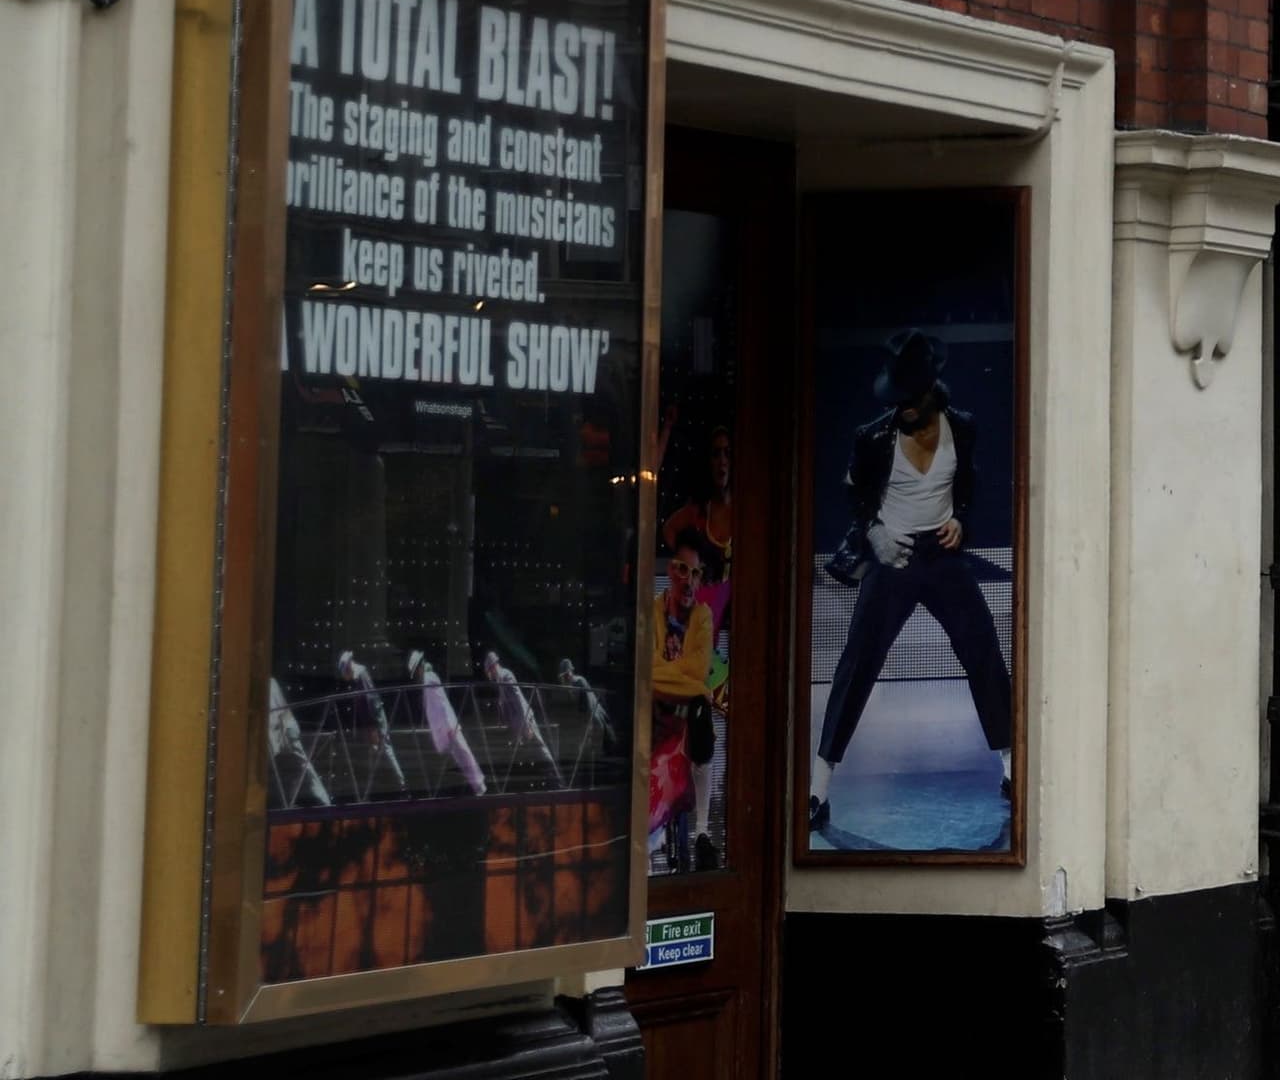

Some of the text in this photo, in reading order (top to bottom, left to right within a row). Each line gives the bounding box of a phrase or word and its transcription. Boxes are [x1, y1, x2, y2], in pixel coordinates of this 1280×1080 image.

[476, 4, 617, 121] BLAST!
[289, 79, 603, 185] The staging and constant
[413, 178, 442, 226] of
[447, 176, 487, 232] the
[495, 189, 616, 249] musicians
[342, 227, 547, 305] keep us riveted.
[301, 300, 495, 388] WONDERFUL
[658, 943, 704, 962] Keep clear
[662, 920, 702, 940] Fire exit
